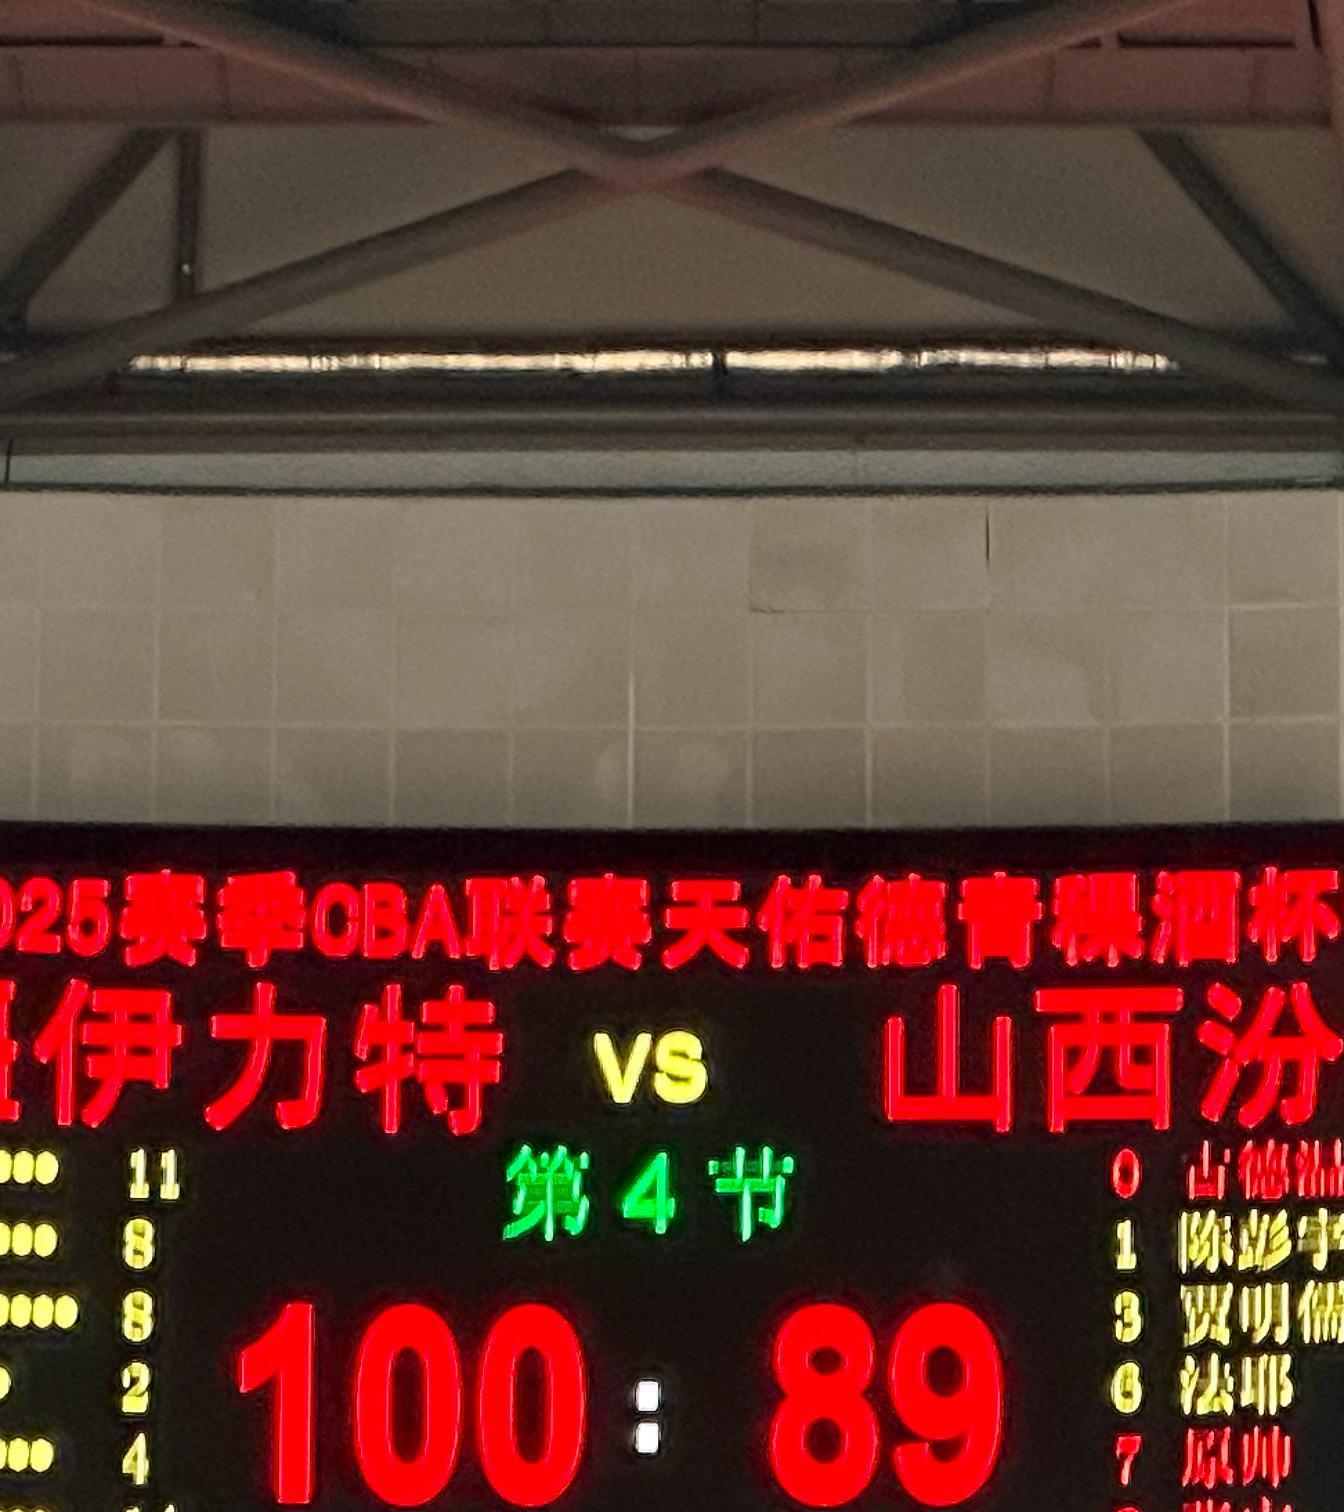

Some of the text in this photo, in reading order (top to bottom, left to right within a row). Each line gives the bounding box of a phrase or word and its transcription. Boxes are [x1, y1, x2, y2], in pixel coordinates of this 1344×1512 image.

[130, 1149, 179, 1199] 11
[1111, 1148, 1142, 1199] 0
[123, 1219, 154, 1269] 8
[1117, 1220, 1136, 1269] 1
[122, 1291, 153, 1342] 8
[1115, 1292, 1141, 1342] 3
[122, 1362, 150, 1412] 2
[237, 1301, 586, 1507] 100
[767, 1302, 1004, 1507] 89
[1111, 1363, 1142, 1413] 6
[123, 1433, 149, 1485] 4
[1116, 1434, 1142, 1485] 7
